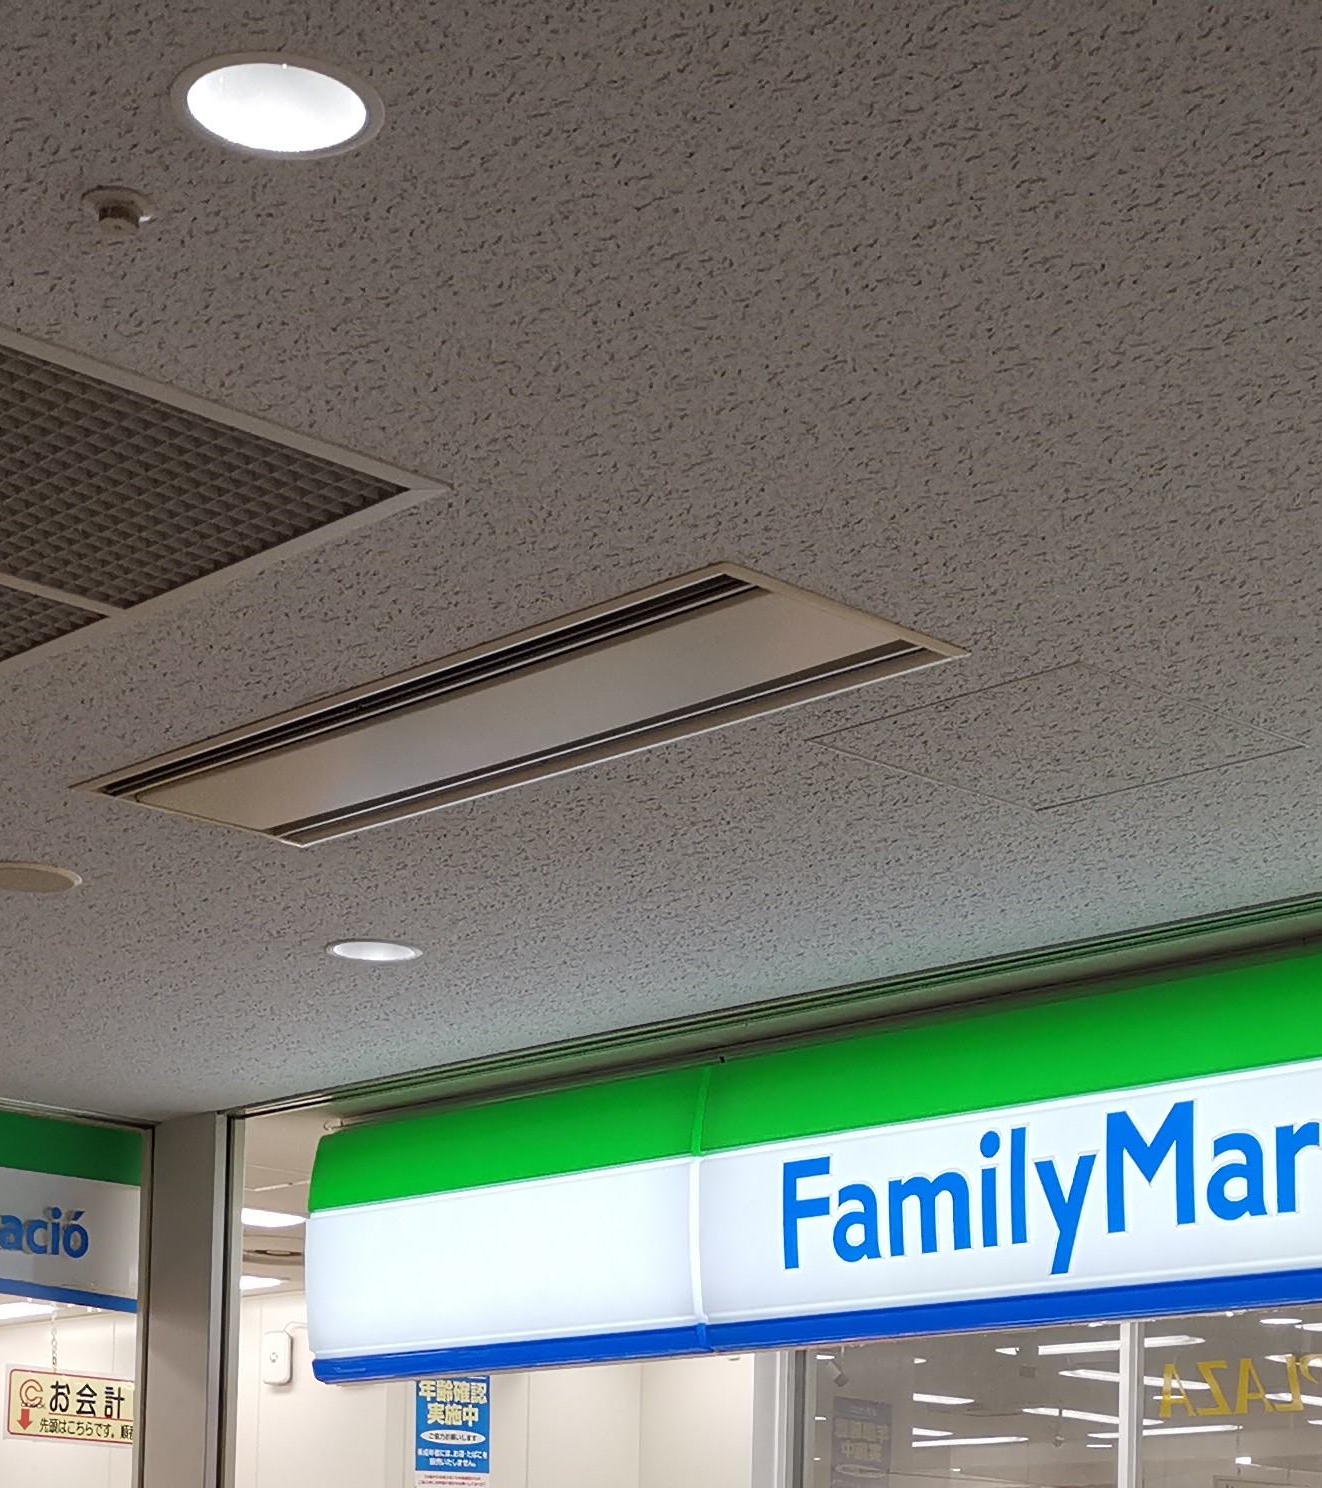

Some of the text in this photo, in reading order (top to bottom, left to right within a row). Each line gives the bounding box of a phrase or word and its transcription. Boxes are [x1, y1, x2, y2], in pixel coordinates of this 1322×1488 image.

[49, 1381, 125, 1419] お会計
[418, 1380, 487, 1404] 年齢確認
[427, 1402, 479, 1427] 実施中
